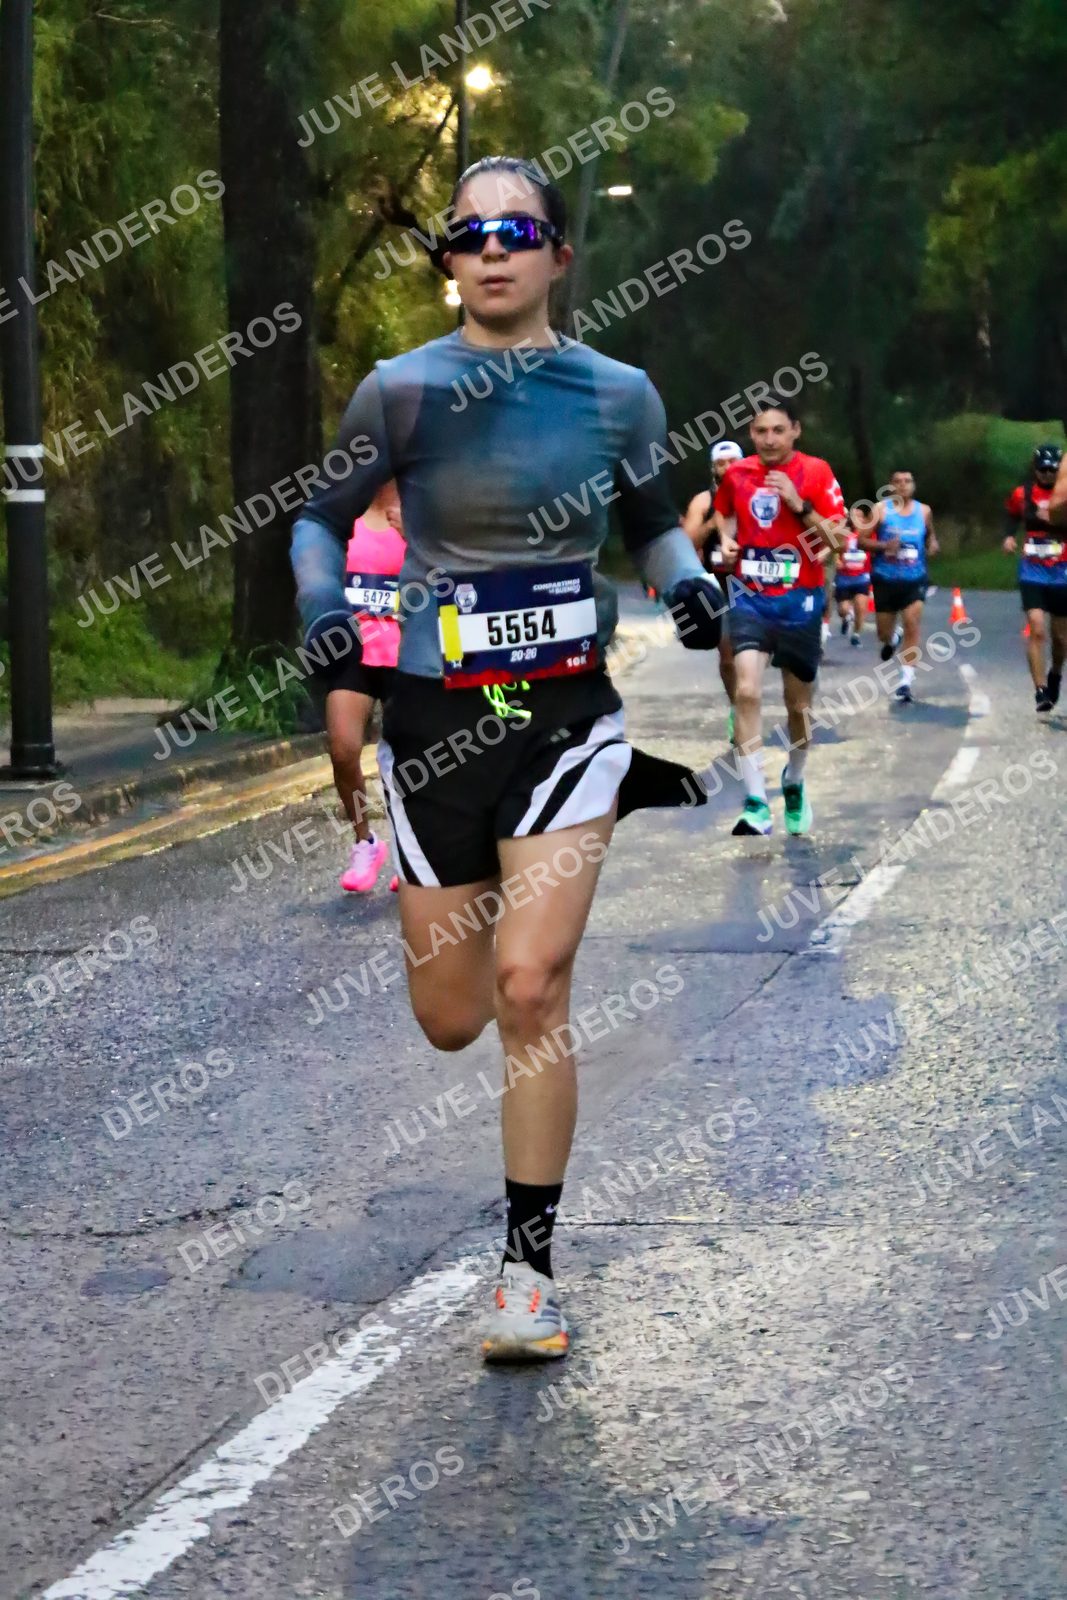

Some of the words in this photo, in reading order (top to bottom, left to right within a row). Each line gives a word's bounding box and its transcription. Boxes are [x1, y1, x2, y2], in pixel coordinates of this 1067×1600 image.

[363, 590, 390, 605] 5472
[487, 608, 557, 646] 5554
[566, 655, 587, 667] 10K
